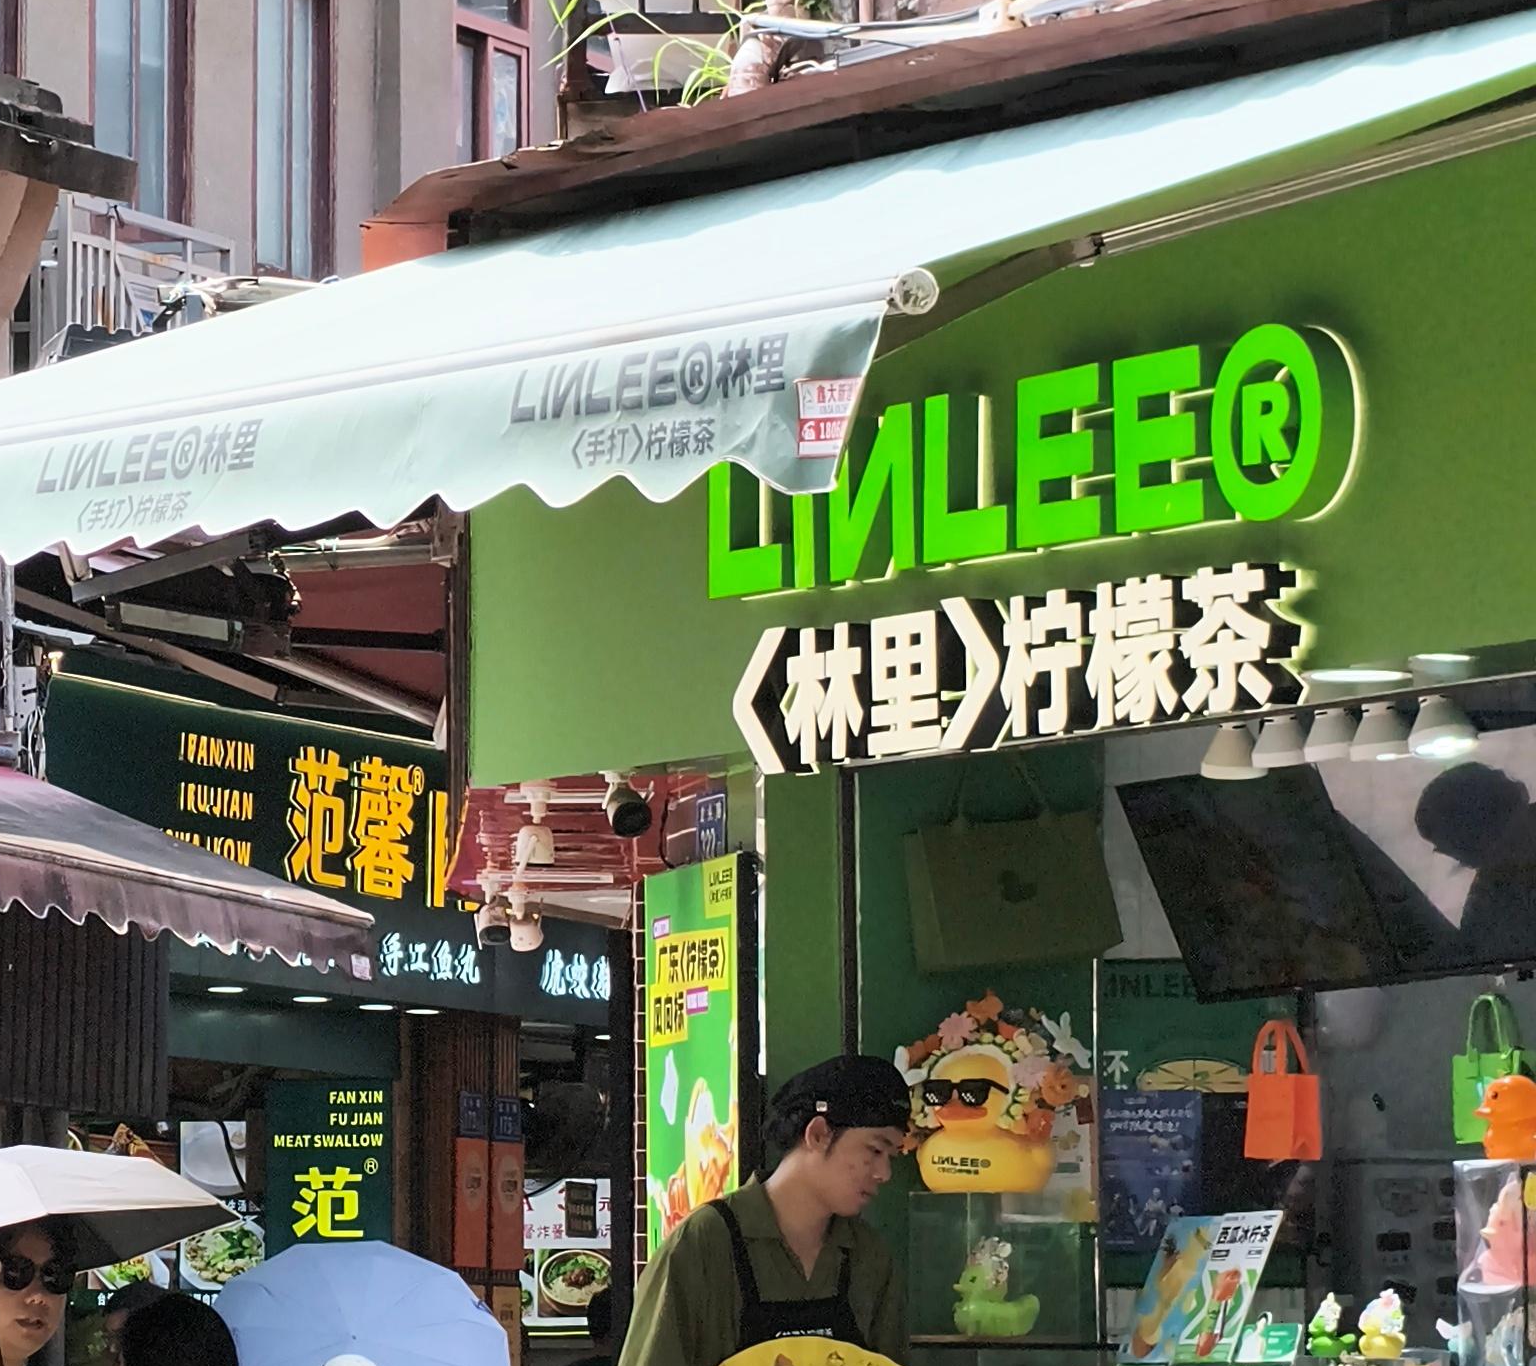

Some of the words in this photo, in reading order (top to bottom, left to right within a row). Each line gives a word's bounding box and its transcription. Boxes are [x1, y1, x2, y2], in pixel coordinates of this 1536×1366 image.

[329, 1091, 356, 1104] FAN
[359, 1090, 383, 1104] XIN
[330, 1113, 348, 1126] FU
[351, 1112, 383, 1125] JIAN
[273, 1135, 311, 1147] MEAT
[314, 1134, 383, 1147] SWALLOW
